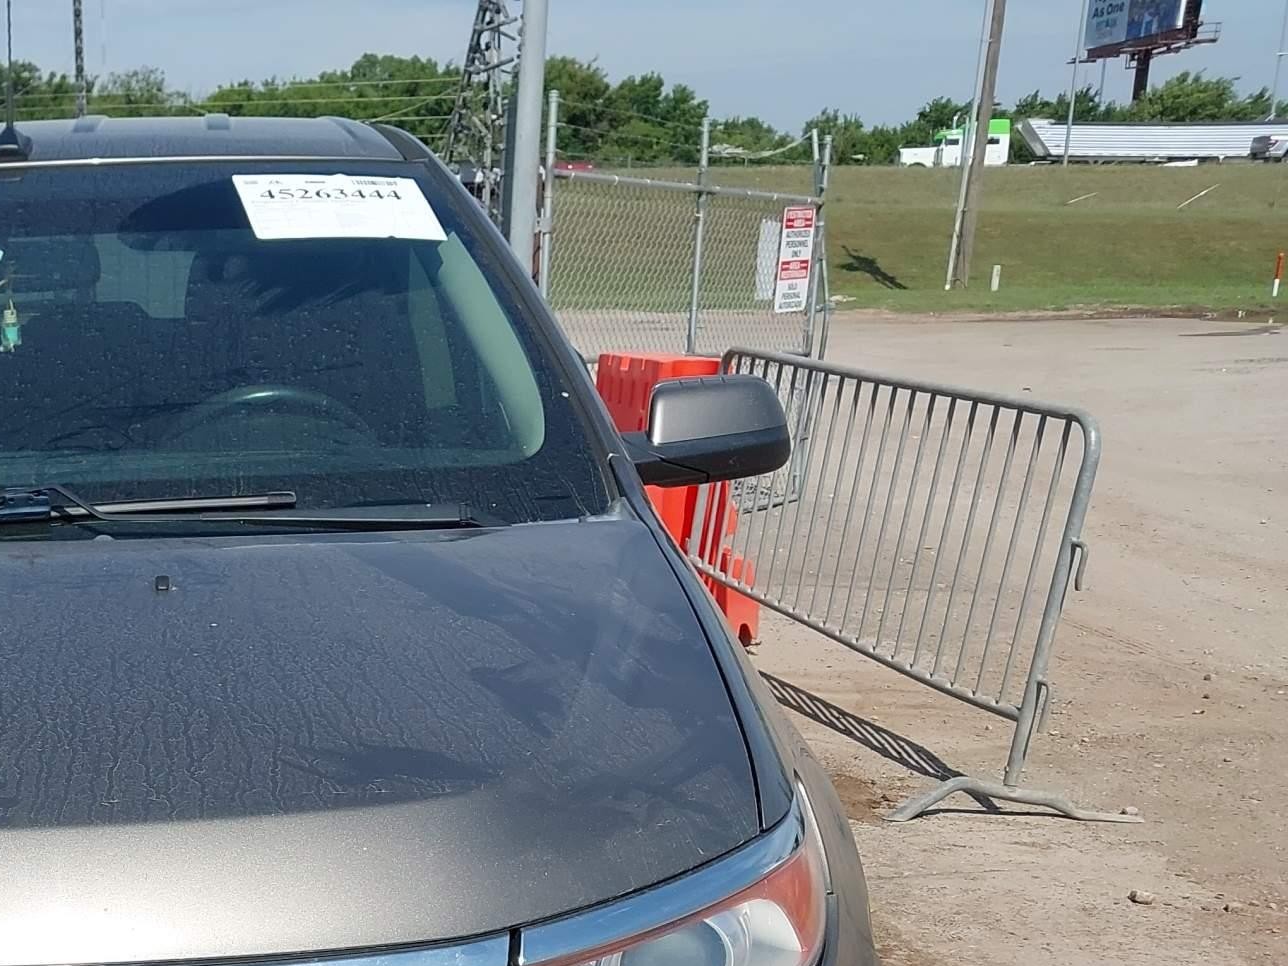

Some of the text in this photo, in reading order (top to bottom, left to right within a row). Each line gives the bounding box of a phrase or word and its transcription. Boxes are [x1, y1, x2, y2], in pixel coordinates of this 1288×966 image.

[1092, 2, 1124, 19] As One
[260, 188, 402, 200] 45263444
